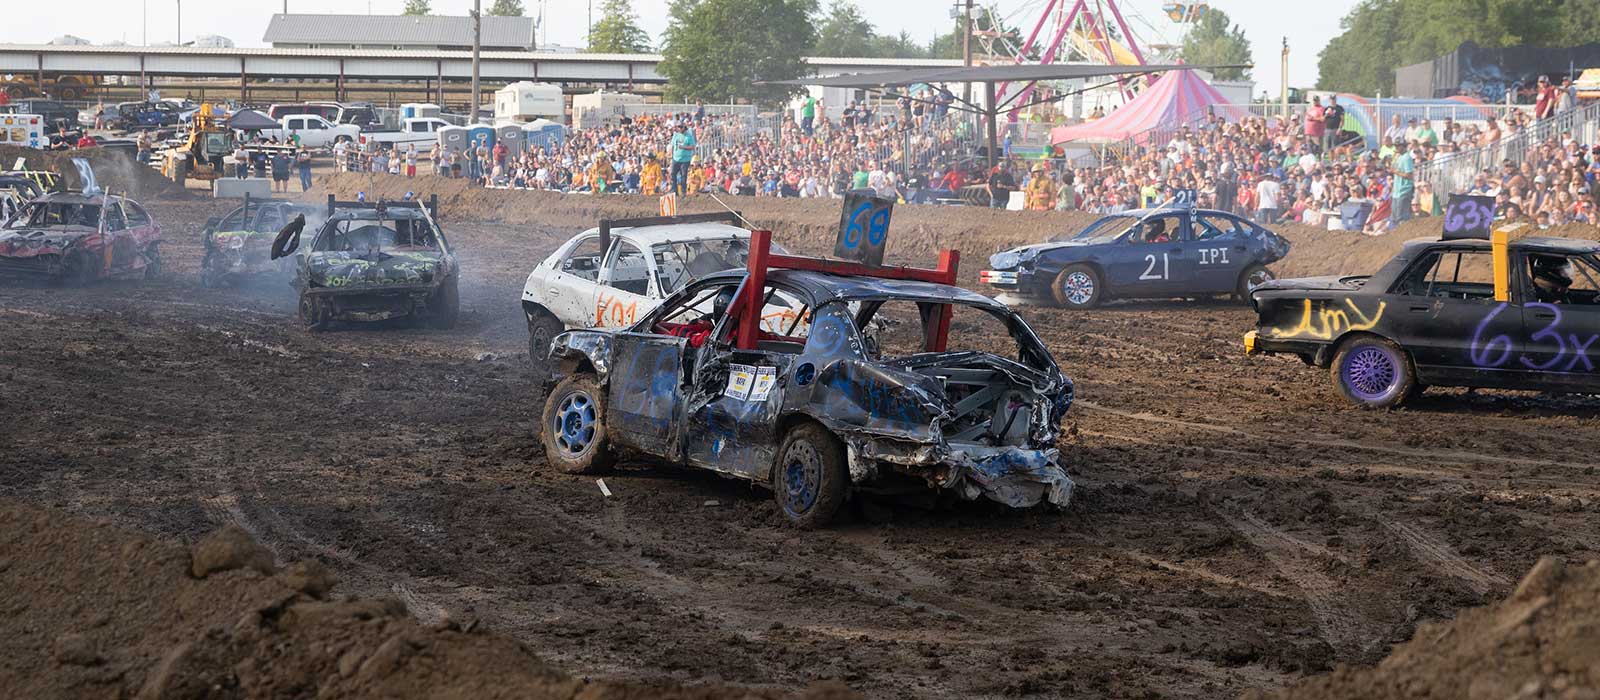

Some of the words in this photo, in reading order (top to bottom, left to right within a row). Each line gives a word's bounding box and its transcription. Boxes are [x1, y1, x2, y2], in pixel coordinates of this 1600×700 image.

[1177, 190, 1193, 204] 21
[1198, 247, 1229, 264] IPI
[1139, 252, 1169, 279] 21
